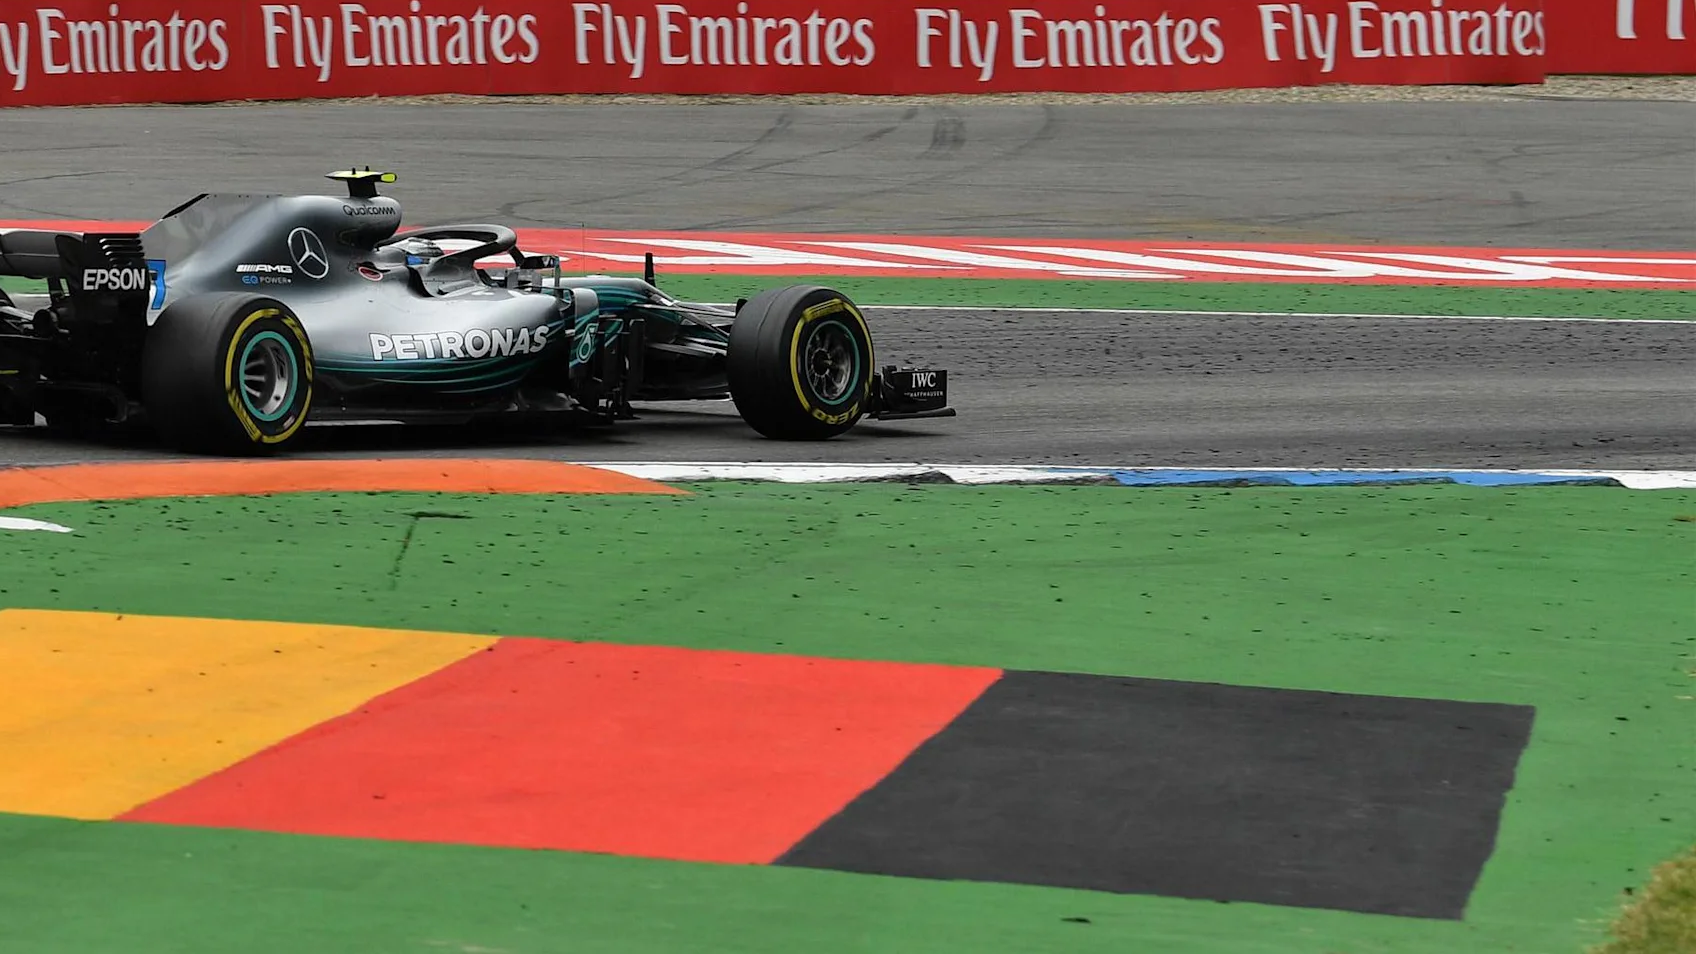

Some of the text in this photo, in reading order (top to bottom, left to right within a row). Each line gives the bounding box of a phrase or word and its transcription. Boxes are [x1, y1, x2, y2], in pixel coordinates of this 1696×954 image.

[36, 4, 228, 74] Emirates
[261, 0, 538, 82] Fly Emirates
[572, 2, 874, 79] Fly Emirates
[915, 5, 1223, 82] Fly Emirates
[1258, 3, 1337, 73] Fly
[342, 204, 396, 217] Qualcomm
[82, 268, 146, 290] EPSON
[254, 264, 293, 274] AMG
[368, 324, 550, 362] PETRONAS
[911, 371, 937, 389] IWC
[811, 401, 860, 425] ZERO
